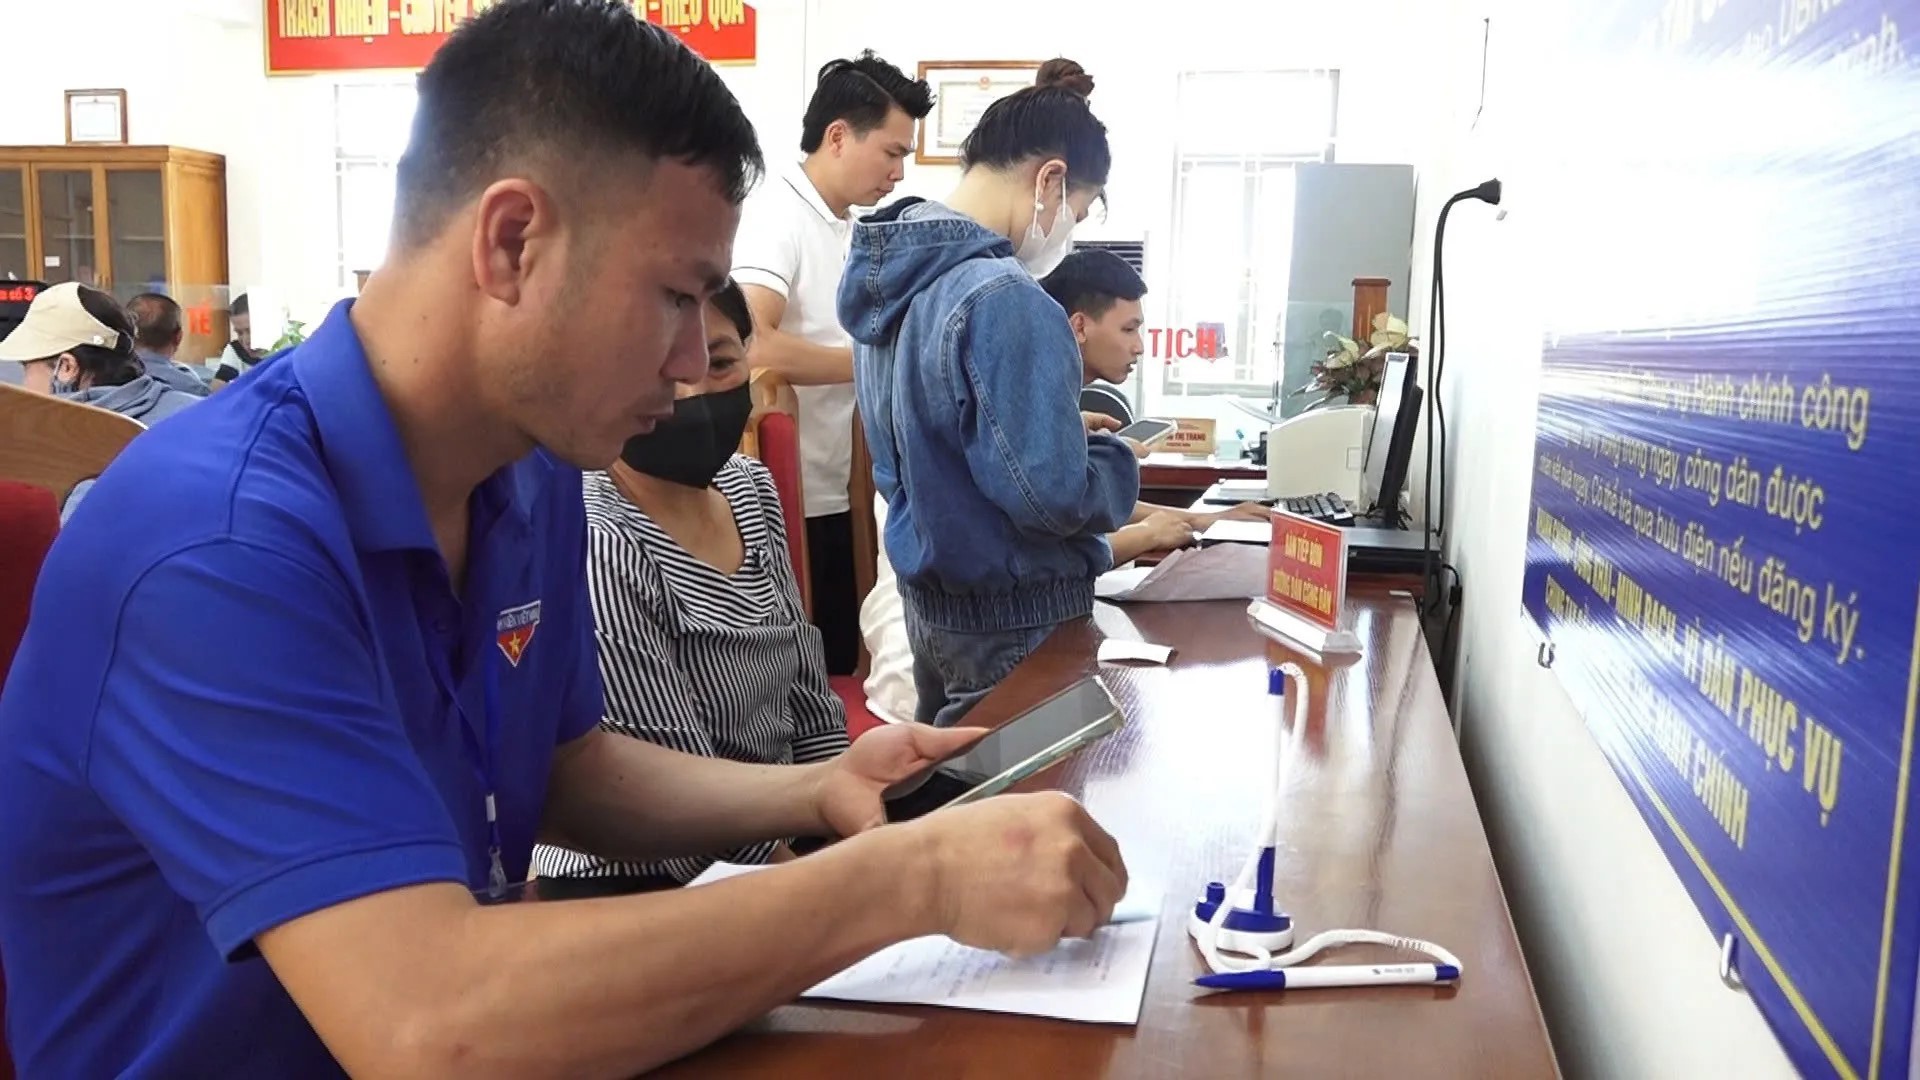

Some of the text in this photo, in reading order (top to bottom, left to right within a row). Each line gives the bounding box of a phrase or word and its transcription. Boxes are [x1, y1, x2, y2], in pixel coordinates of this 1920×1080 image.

[1147, 328, 1217, 365] TỊCH
[1694, 372, 1735, 418] Hành
[1739, 372, 1795, 425] chính
[1801, 373, 1870, 451] công
[1684, 448, 1720, 507] công
[1726, 453, 1760, 510] dân
[1765, 464, 1825, 535] được
[1633, 503, 1653, 540] qua
[1656, 505, 1680, 553] bưu
[1682, 513, 1713, 575] điện
[1718, 535, 1753, 595] nếu
[1757, 556, 1817, 643] đăng
[1693, 736, 1749, 851] CHÍNH
[1736, 666, 1799, 772] PHỤC
[1803, 715, 1843, 828] VỤ
